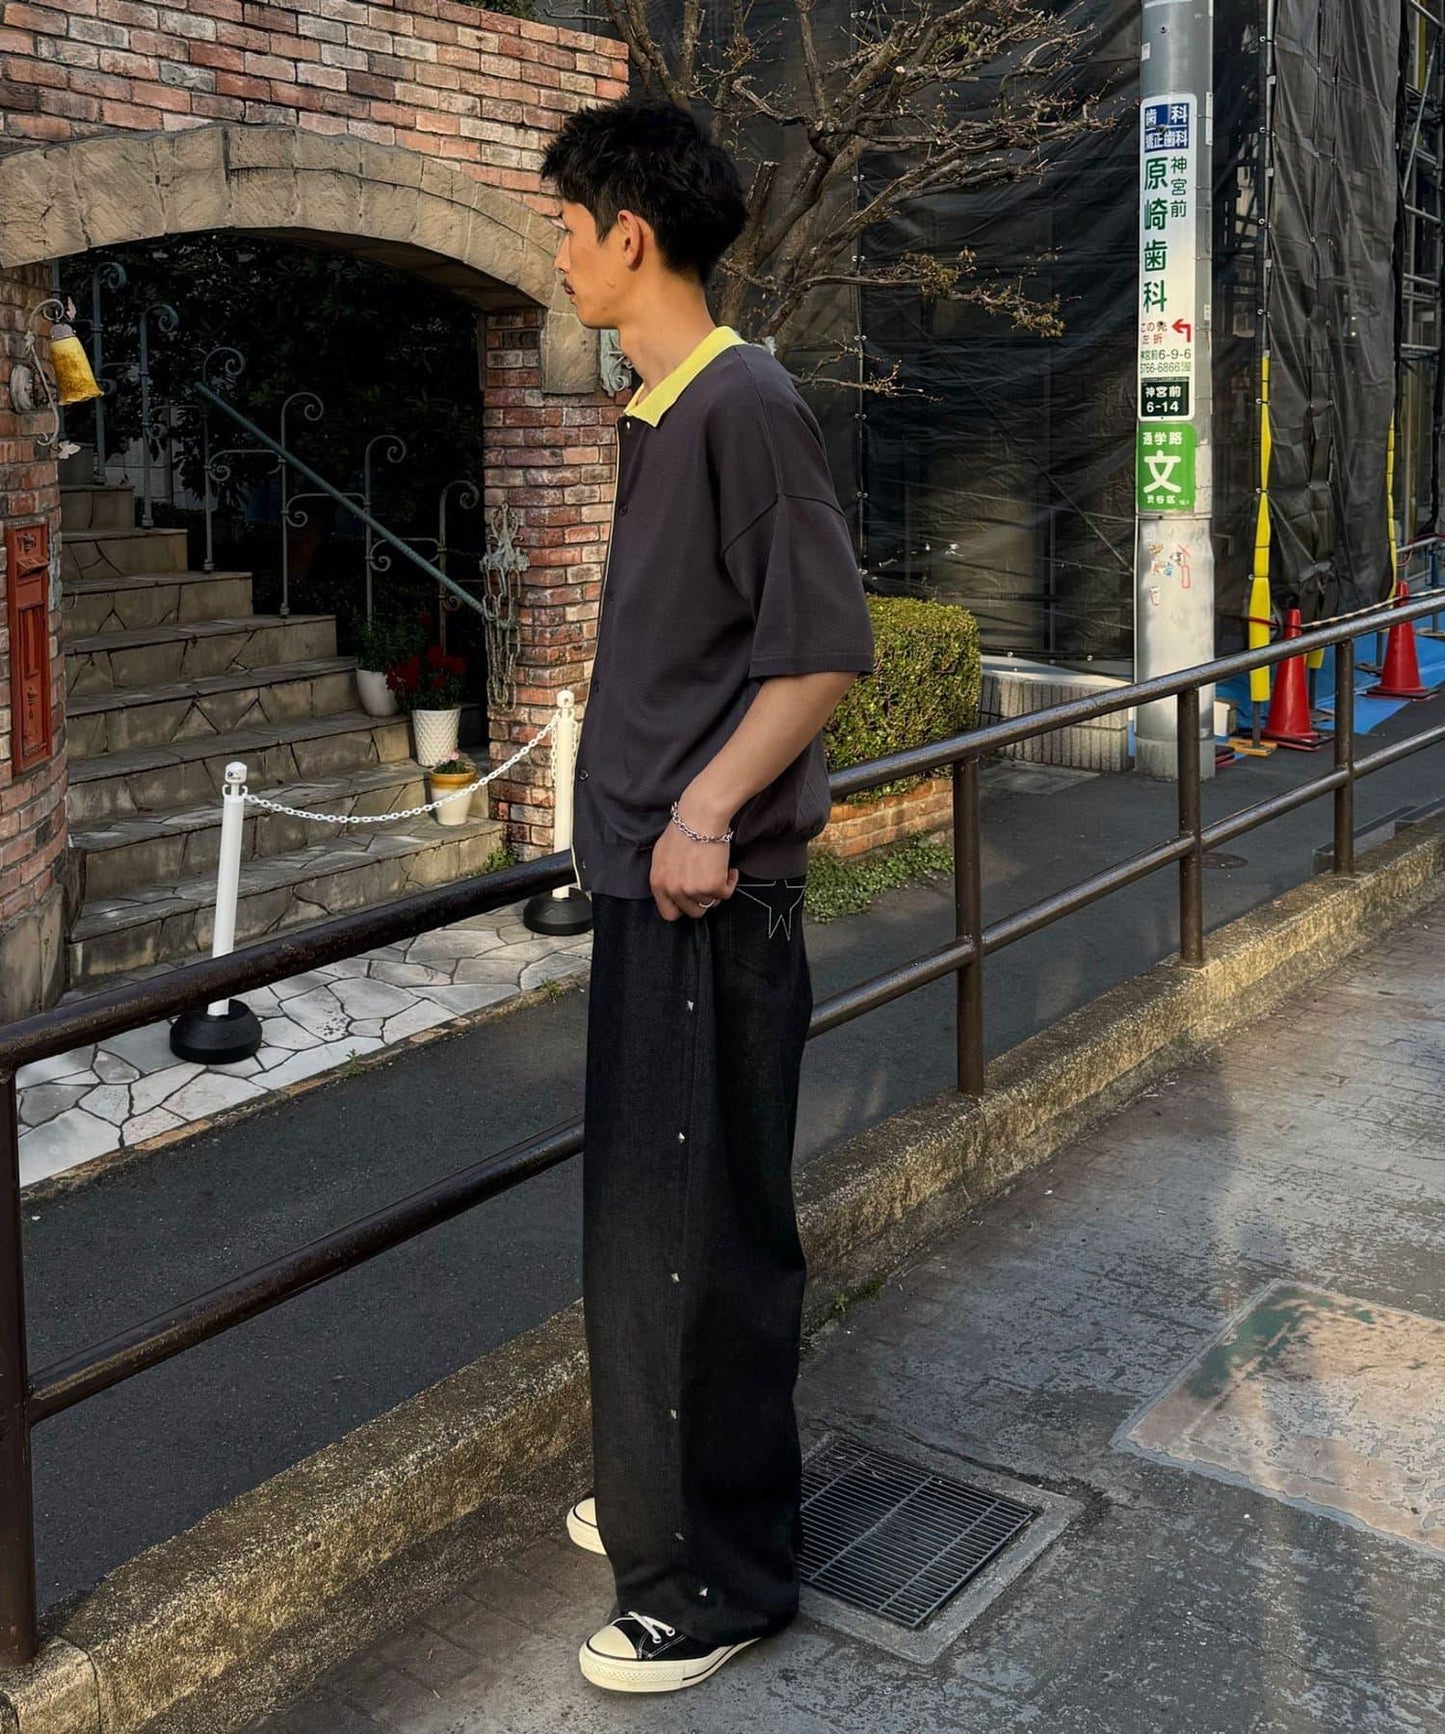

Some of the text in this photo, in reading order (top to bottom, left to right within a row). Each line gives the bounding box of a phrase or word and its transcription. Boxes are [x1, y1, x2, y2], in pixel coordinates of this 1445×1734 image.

[1171, 156, 1188, 218] 神宮前
[1144, 157, 1168, 313] 原崎歯科
[1145, 385, 1182, 398] 神宮前
[1146, 401, 1179, 413] 6-14
[1143, 432, 1182, 446] 通学路
[1143, 450, 1182, 493] 文
